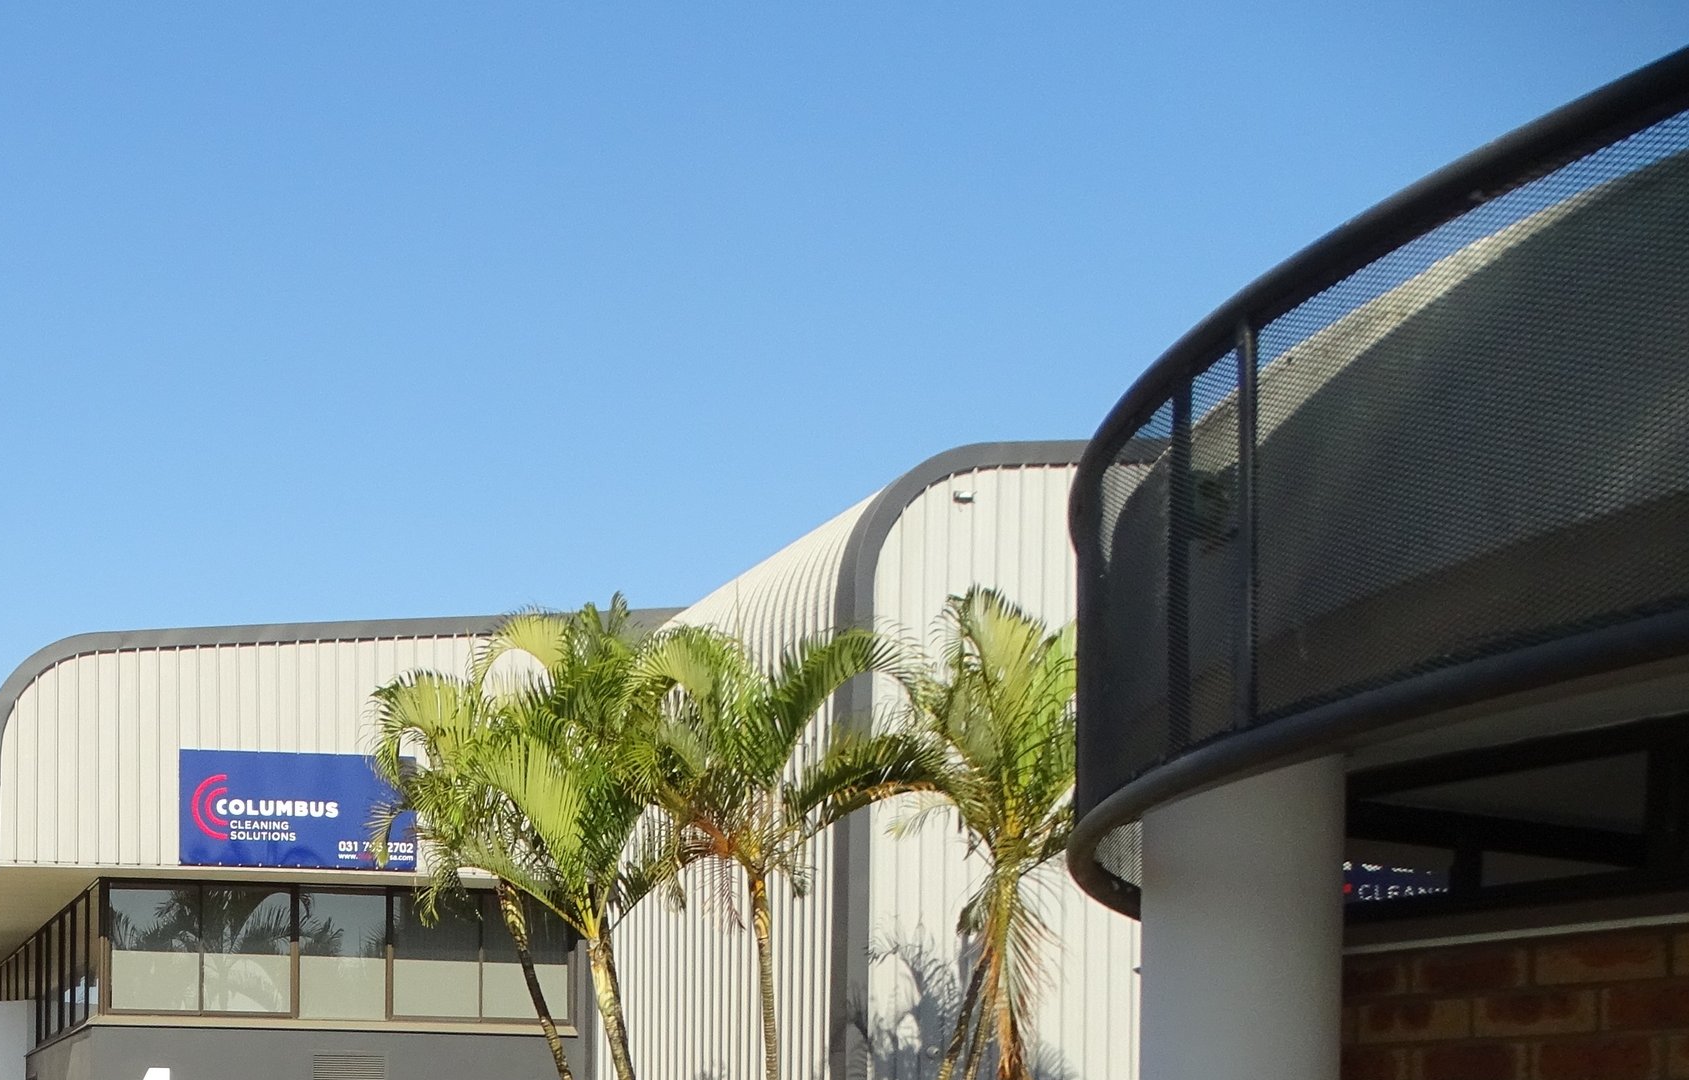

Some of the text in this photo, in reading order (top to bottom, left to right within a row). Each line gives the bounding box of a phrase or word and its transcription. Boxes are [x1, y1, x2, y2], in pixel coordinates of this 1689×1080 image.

[215, 798, 339, 818] COLUMBUS
[229, 820, 289, 831] CLEANING
[230, 830, 296, 841] SOLUTIONS
[338, 840, 358, 852] 031
[387, 842, 414, 854] 2702
